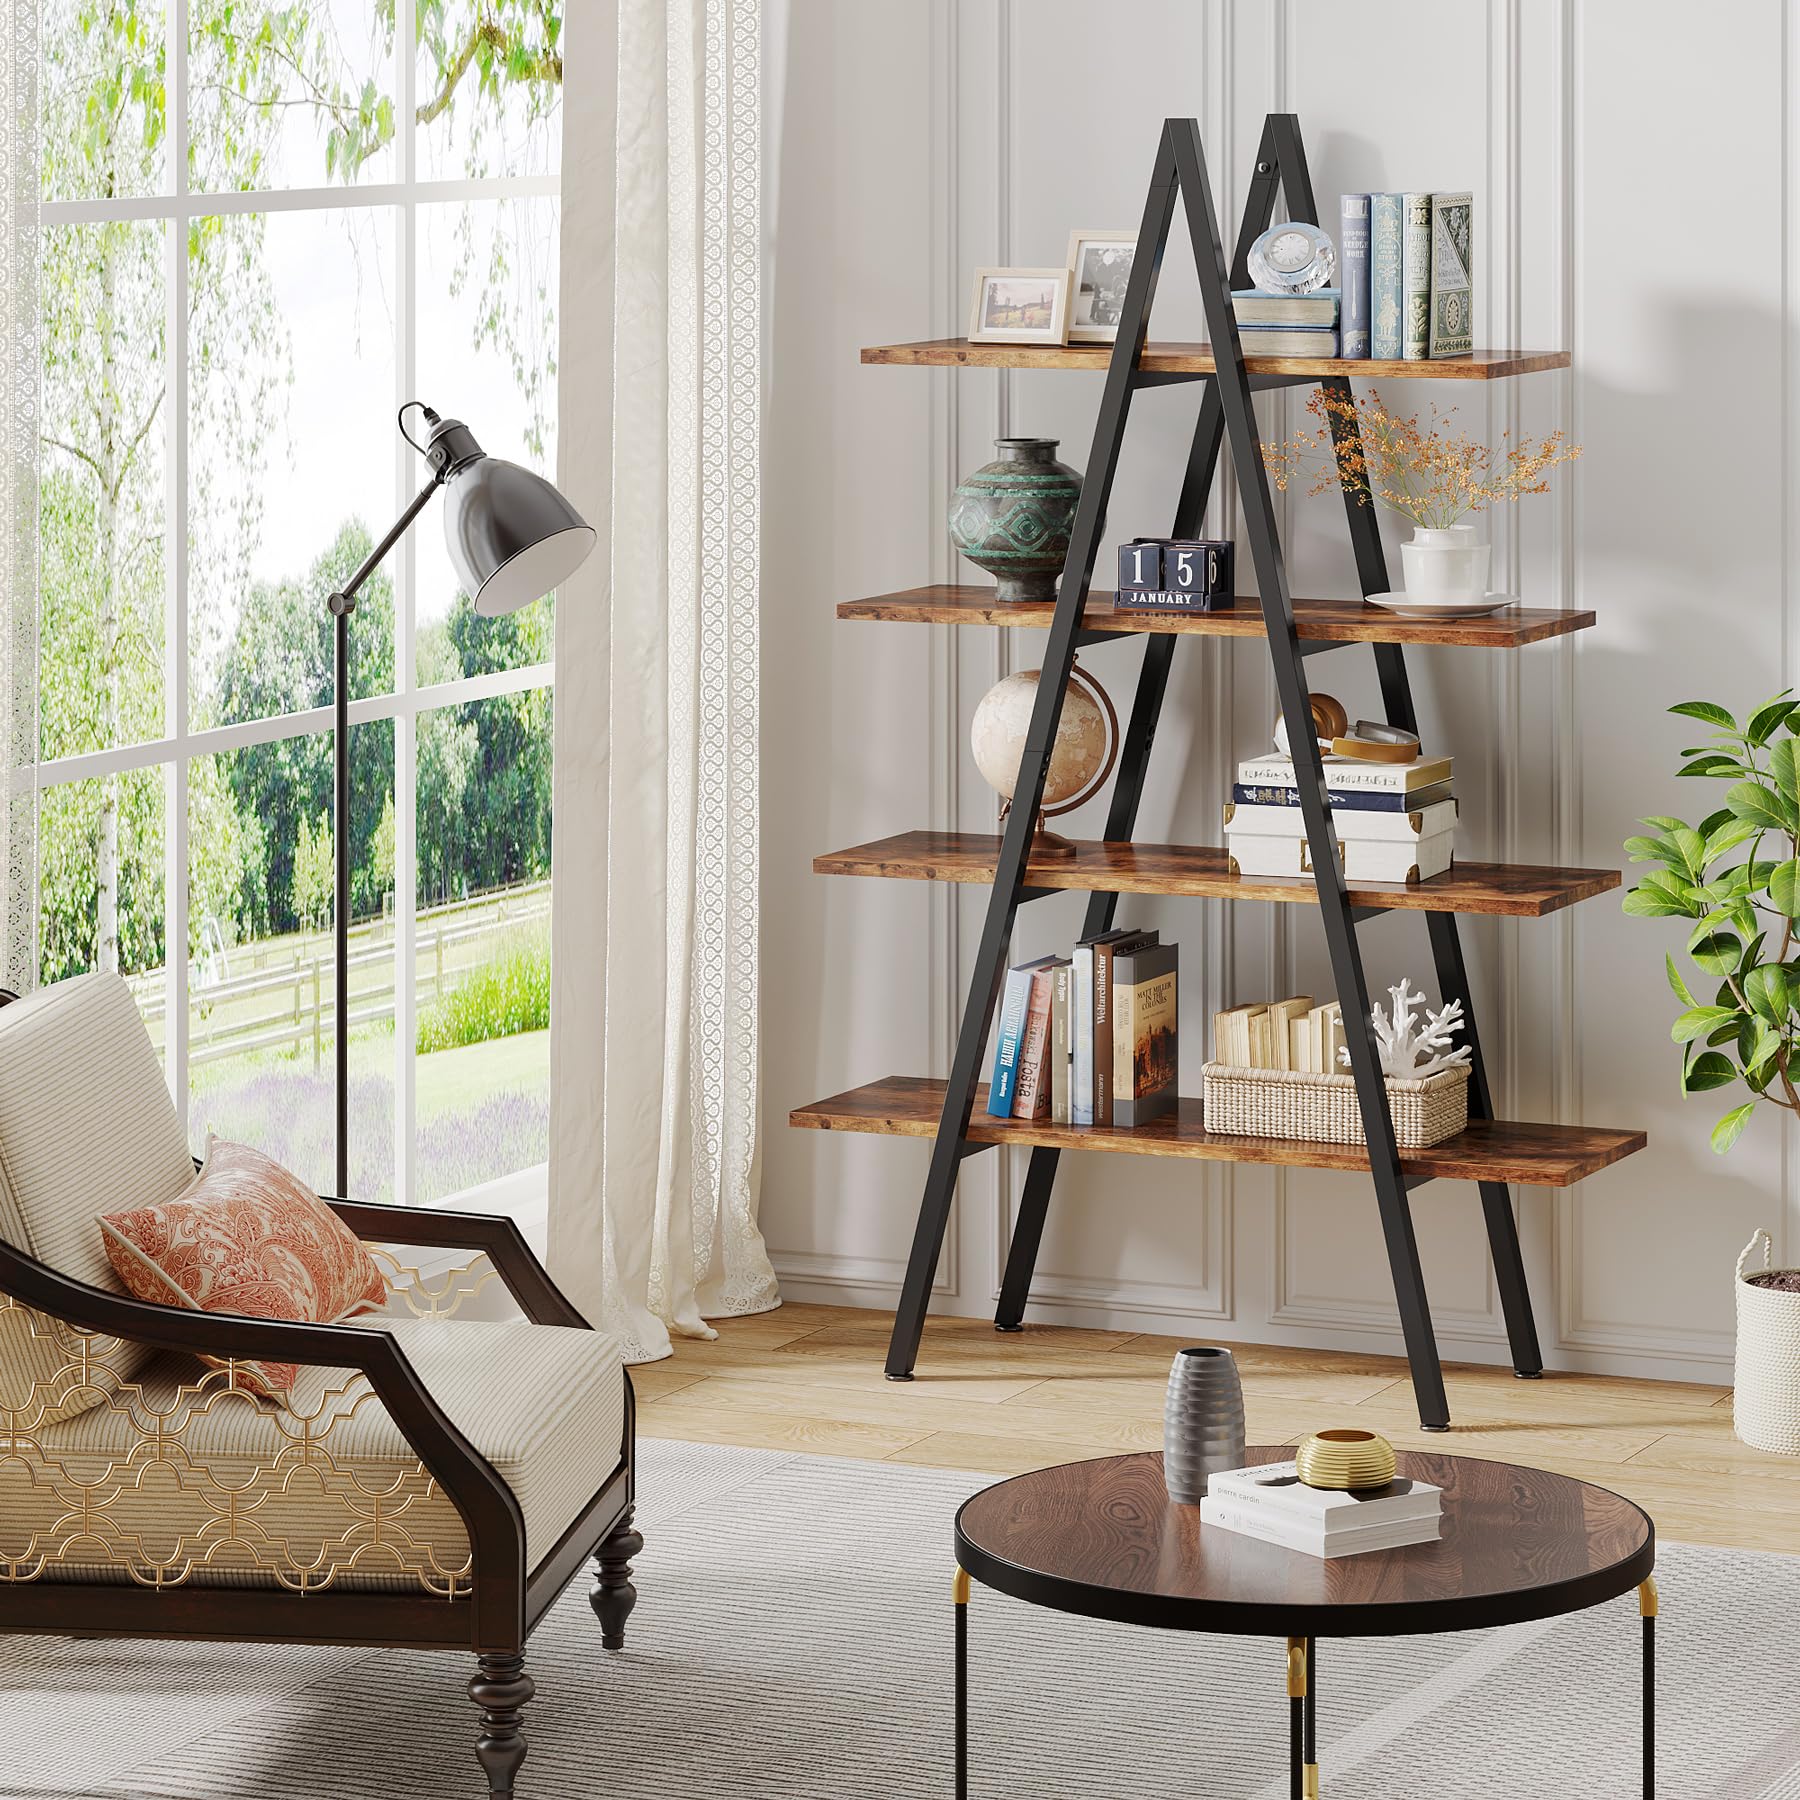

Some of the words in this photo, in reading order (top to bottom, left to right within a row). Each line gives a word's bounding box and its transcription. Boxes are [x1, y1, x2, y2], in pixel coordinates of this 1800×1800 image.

[1346, 249, 1365, 258] WORK
[1132, 549, 1144, 584] 1
[1177, 552, 1193, 587] 5
[1210, 550, 1217, 585] 6
[1130, 592, 1193, 605] JANUARY
[1096, 954, 1107, 1025] Weltarchitektur
[1137, 988, 1152, 1000] MATT
[1153, 982, 1172, 993] MILLER
[1027, 1014, 1041, 1055] Bukowski
[1217, 1487, 1237, 1497] pierre
[1239, 1492, 1260, 1504] cardin
